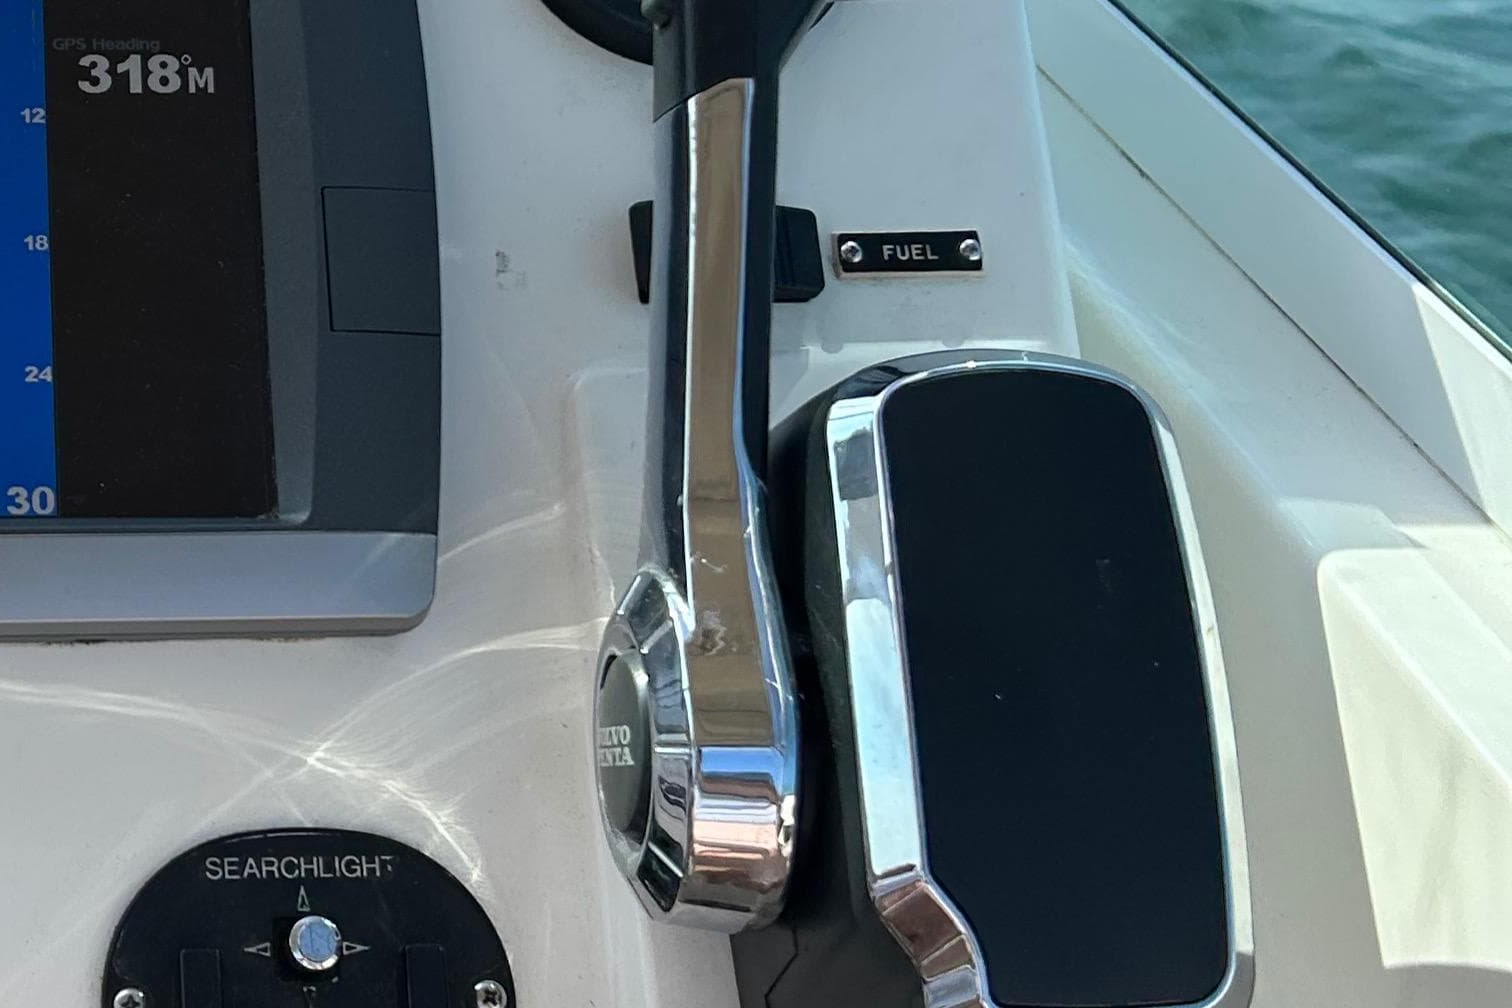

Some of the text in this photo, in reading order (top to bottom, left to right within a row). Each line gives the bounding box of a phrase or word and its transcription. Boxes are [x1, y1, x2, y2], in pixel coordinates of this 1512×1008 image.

[52, 38, 161, 53] GPS Heading
[20, 108, 46, 124] 12
[23, 235, 49, 250] 18
[882, 244, 940, 261] FUEL
[24, 366, 53, 382] 24
[6, 486, 55, 515] 30
